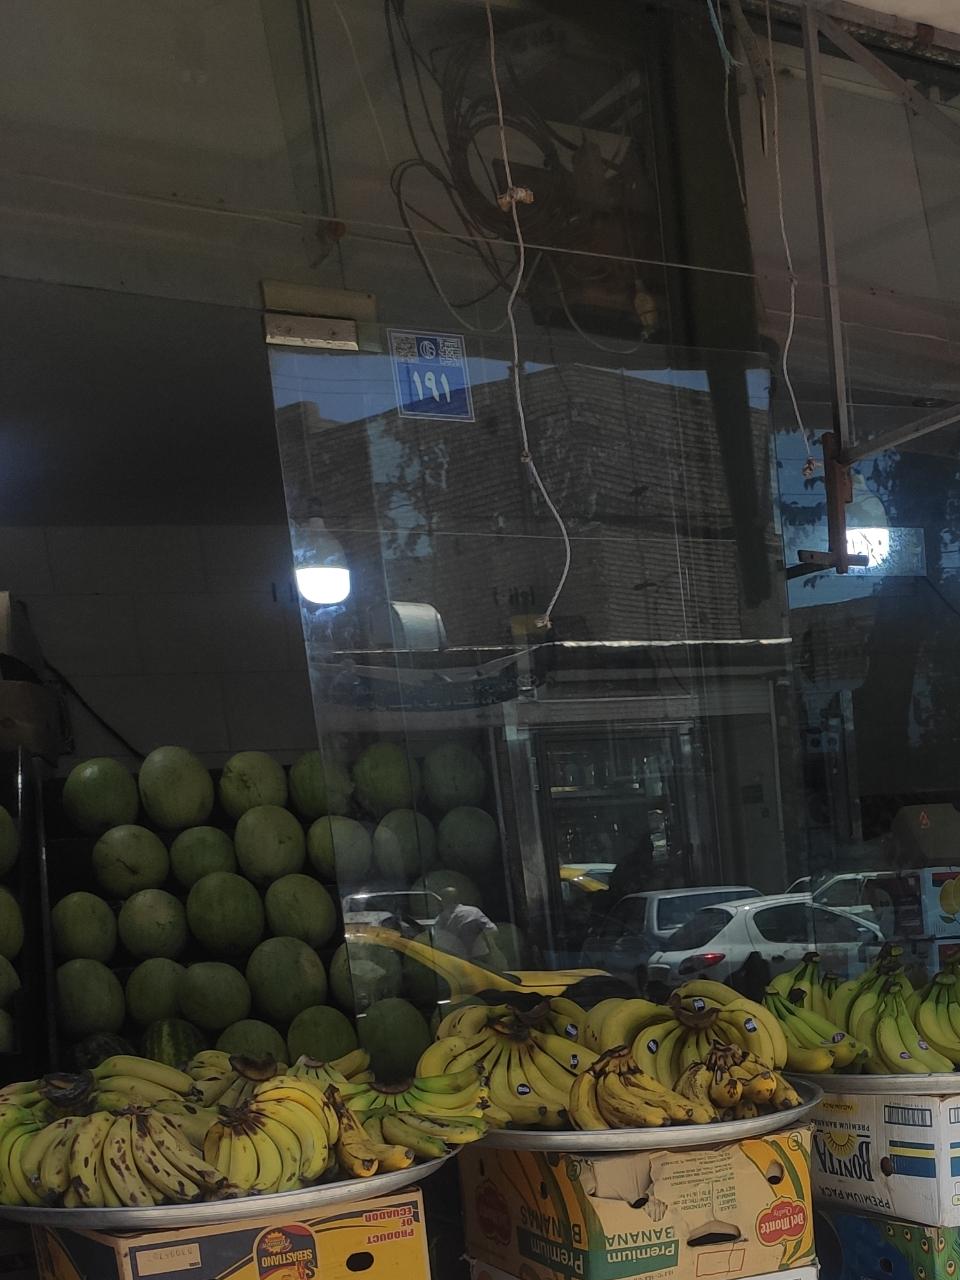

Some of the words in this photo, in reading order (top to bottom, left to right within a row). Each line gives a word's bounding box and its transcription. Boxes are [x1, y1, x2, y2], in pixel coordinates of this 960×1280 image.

[839, 1122, 870, 1131] PREMIUM
[814, 1136, 873, 1182] BONITA
[819, 1186, 843, 1199] PACK
[845, 1192, 890, 1209] PREMIUM
[364, 1207, 413, 1222] ECUADOR
[400, 1217, 413, 1227] OF
[791, 1215, 804, 1225] Del
[520, 1206, 581, 1243] BNANAS
[760, 1219, 790, 1234] Monte
[367, 1229, 414, 1244] PRODUCT
[262, 1249, 312, 1266] SEBASTIANO
[530, 1239, 584, 1274] Premium
[607, 1243, 675, 1264] Premium
